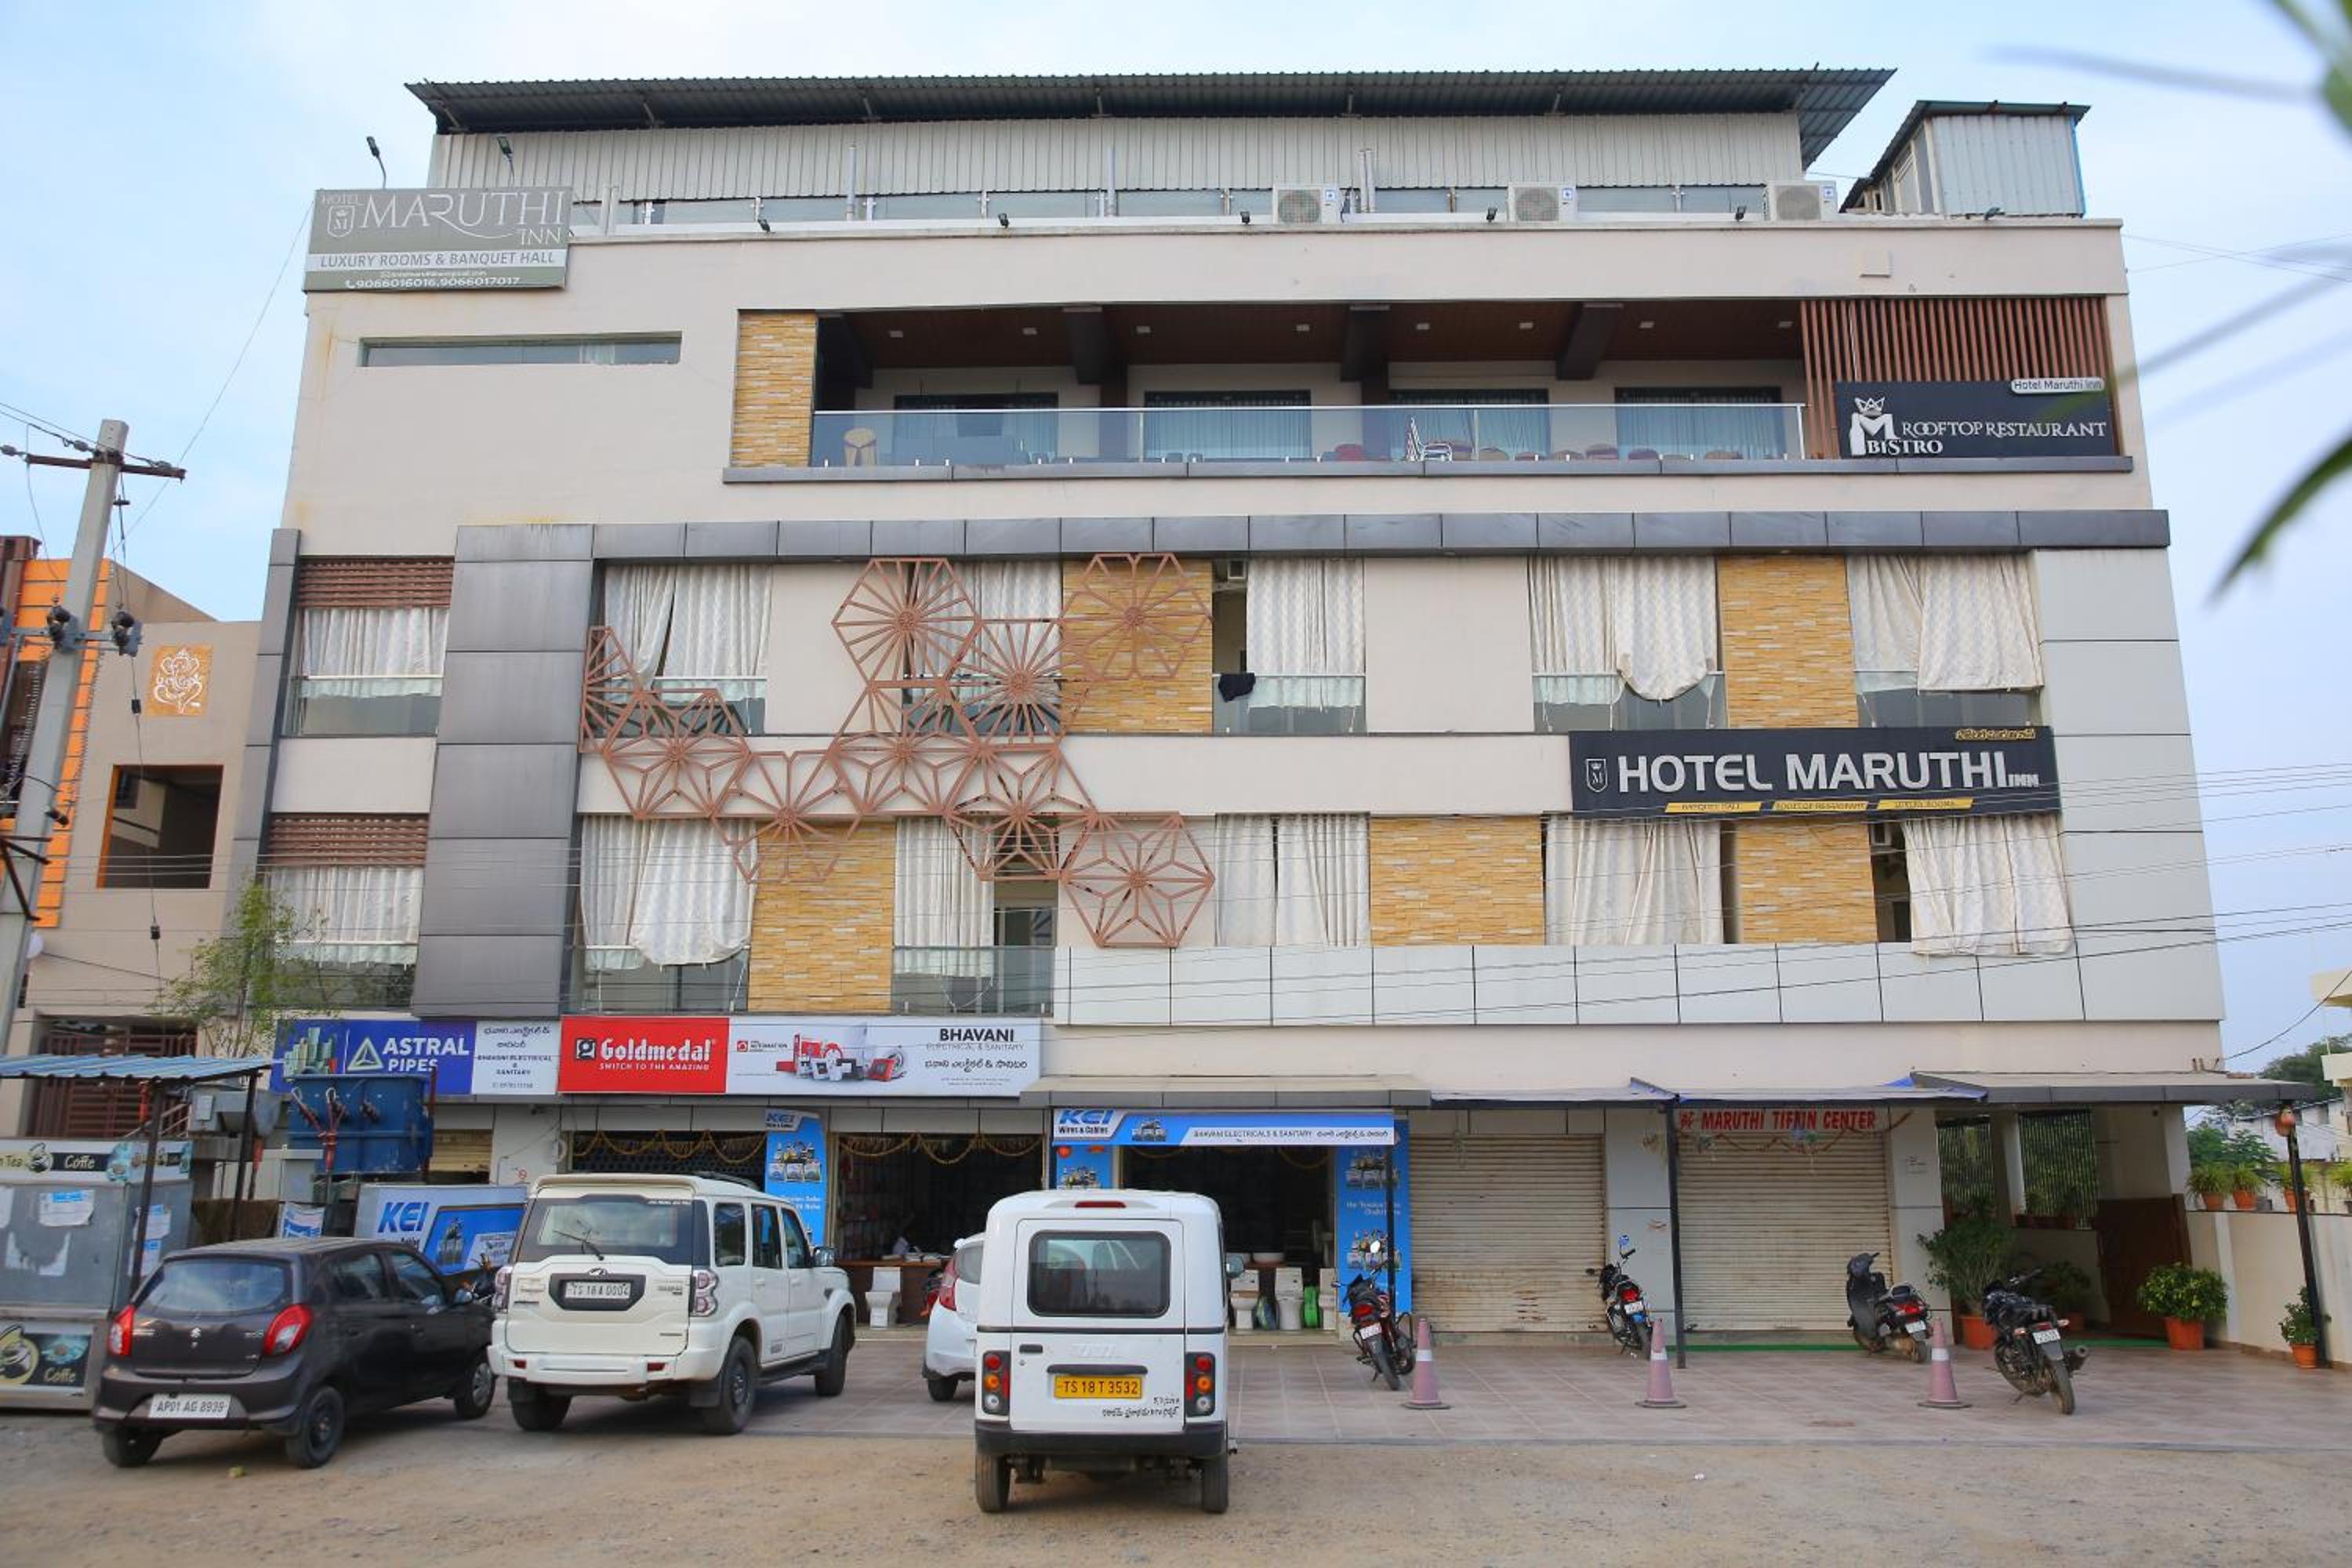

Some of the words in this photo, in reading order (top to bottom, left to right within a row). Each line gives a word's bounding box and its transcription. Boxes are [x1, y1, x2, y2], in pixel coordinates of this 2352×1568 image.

[360, 191, 564, 238] MARUTHI
[518, 227, 563, 245] INN
[320, 254, 374, 268] LUXURY
[379, 253, 431, 267] ROOMS
[435, 253, 445, 266] &
[449, 251, 517, 266] BANQUET
[519, 251, 555, 264] HALL
[2014, 379, 2042, 390] Hotel
[2044, 379, 2083, 390] Maruthi
[2085, 379, 2103, 390] Inn
[1902, 420, 1983, 437] ROOFTOP
[1986, 421, 2107, 438] RESTAURANT
[1617, 753, 1773, 793] HOTEL
[1786, 750, 2007, 789] MARUTHI
[2008, 773, 2038, 787] INN
[940, 1028, 1014, 1042] BHAVANI
[383, 1036, 470, 1056] ASTRAL
[601, 1038, 710, 1061] Goldmedal
[388, 1058, 438, 1073] PIPES
[1059, 1109, 1111, 1124] KEI
[1700, 1110, 1764, 1131] MARUTHI
[1773, 1110, 1816, 1129] TIFFIN
[1823, 1110, 1876, 1129] CENTER
[1058, 1125, 1078, 1135] Wires
[1086, 1126, 1109, 1135] Cables
[64, 1154, 95, 1170] Coffe
[378, 1201, 430, 1233] KEI
[44, 1367, 76, 1383] Coffe
[1063, 1380, 1079, 1393] TS
[1082, 1380, 1096, 1393] 18
[1099, 1380, 1105, 1393] T
[1108, 1380, 1138, 1394] 3532
